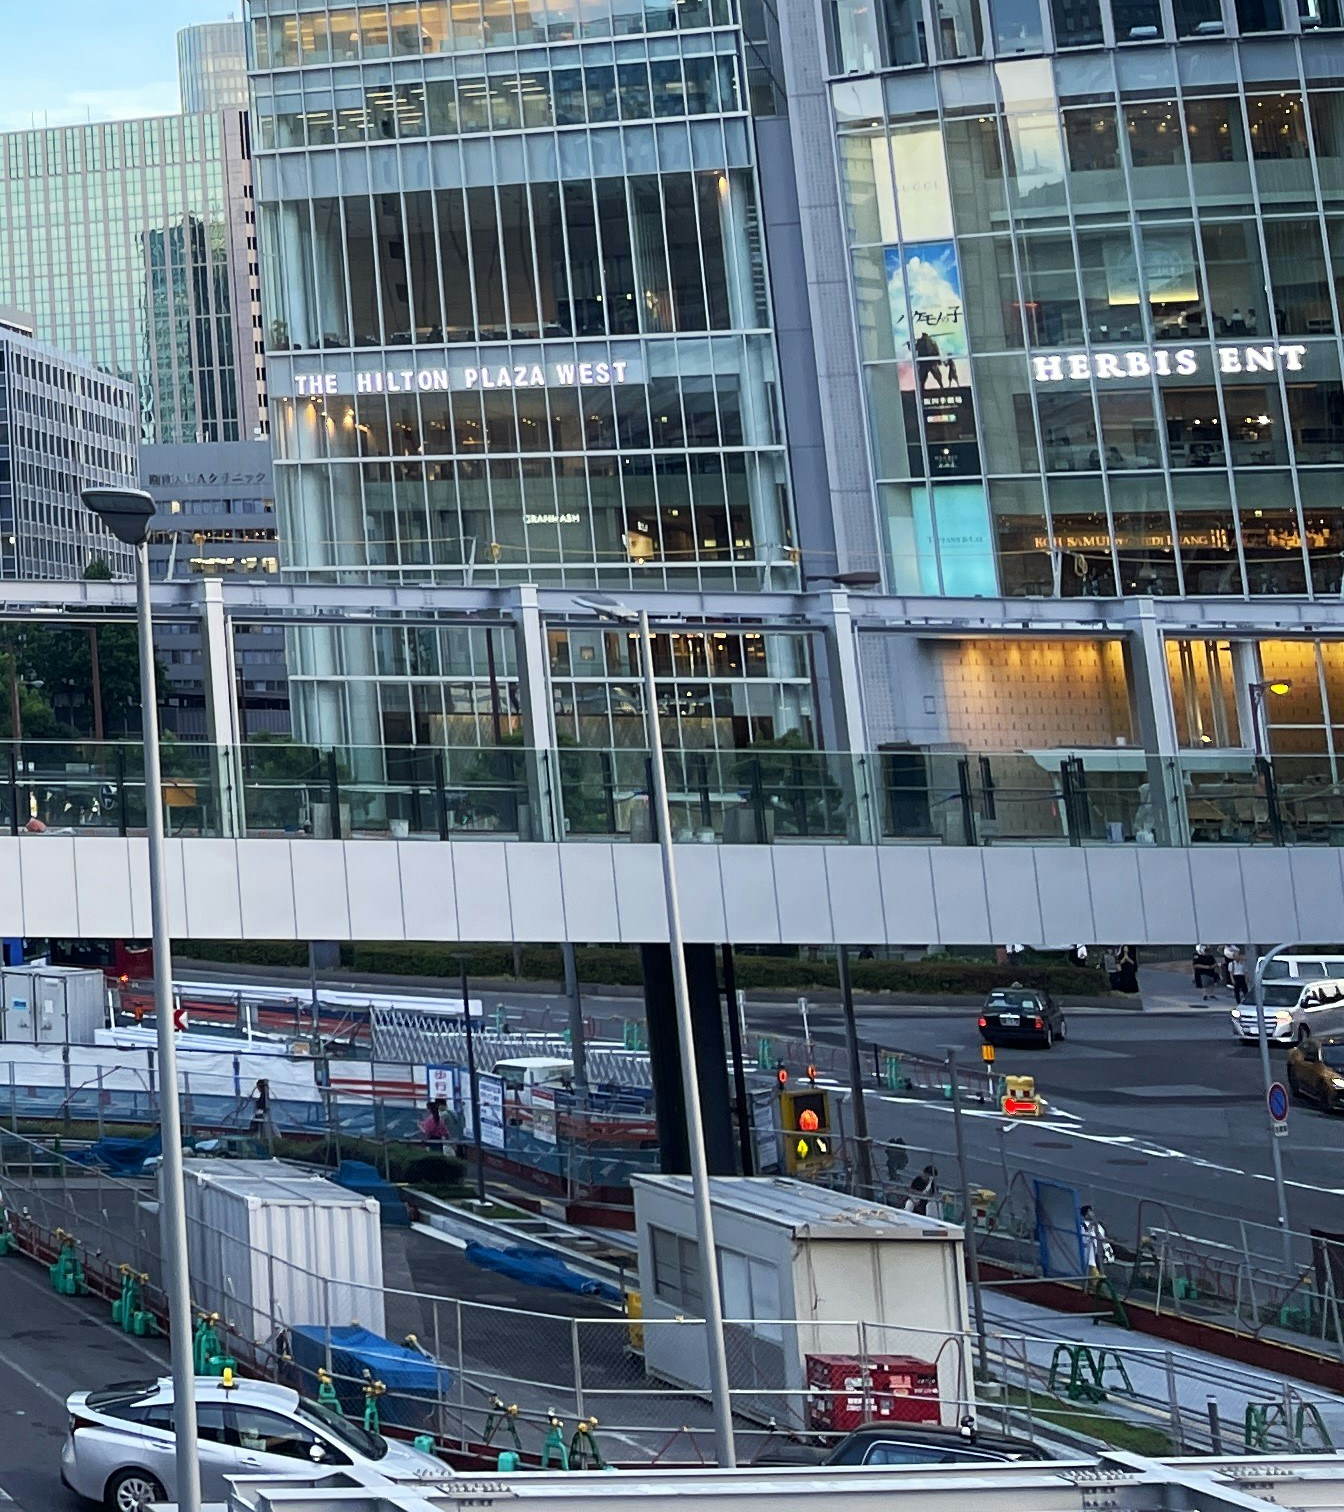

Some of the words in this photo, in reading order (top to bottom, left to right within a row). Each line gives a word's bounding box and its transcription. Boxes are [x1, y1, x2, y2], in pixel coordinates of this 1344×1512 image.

[295, 374, 338, 395] THE
[357, 369, 449, 393] HILTON
[465, 365, 545, 389] PLAZA
[557, 361, 627, 385] WEST
[1032, 349, 1197, 381] HERBIS
[1219, 345, 1306, 373] ENT
[1166, 535, 1208, 546] LANG
